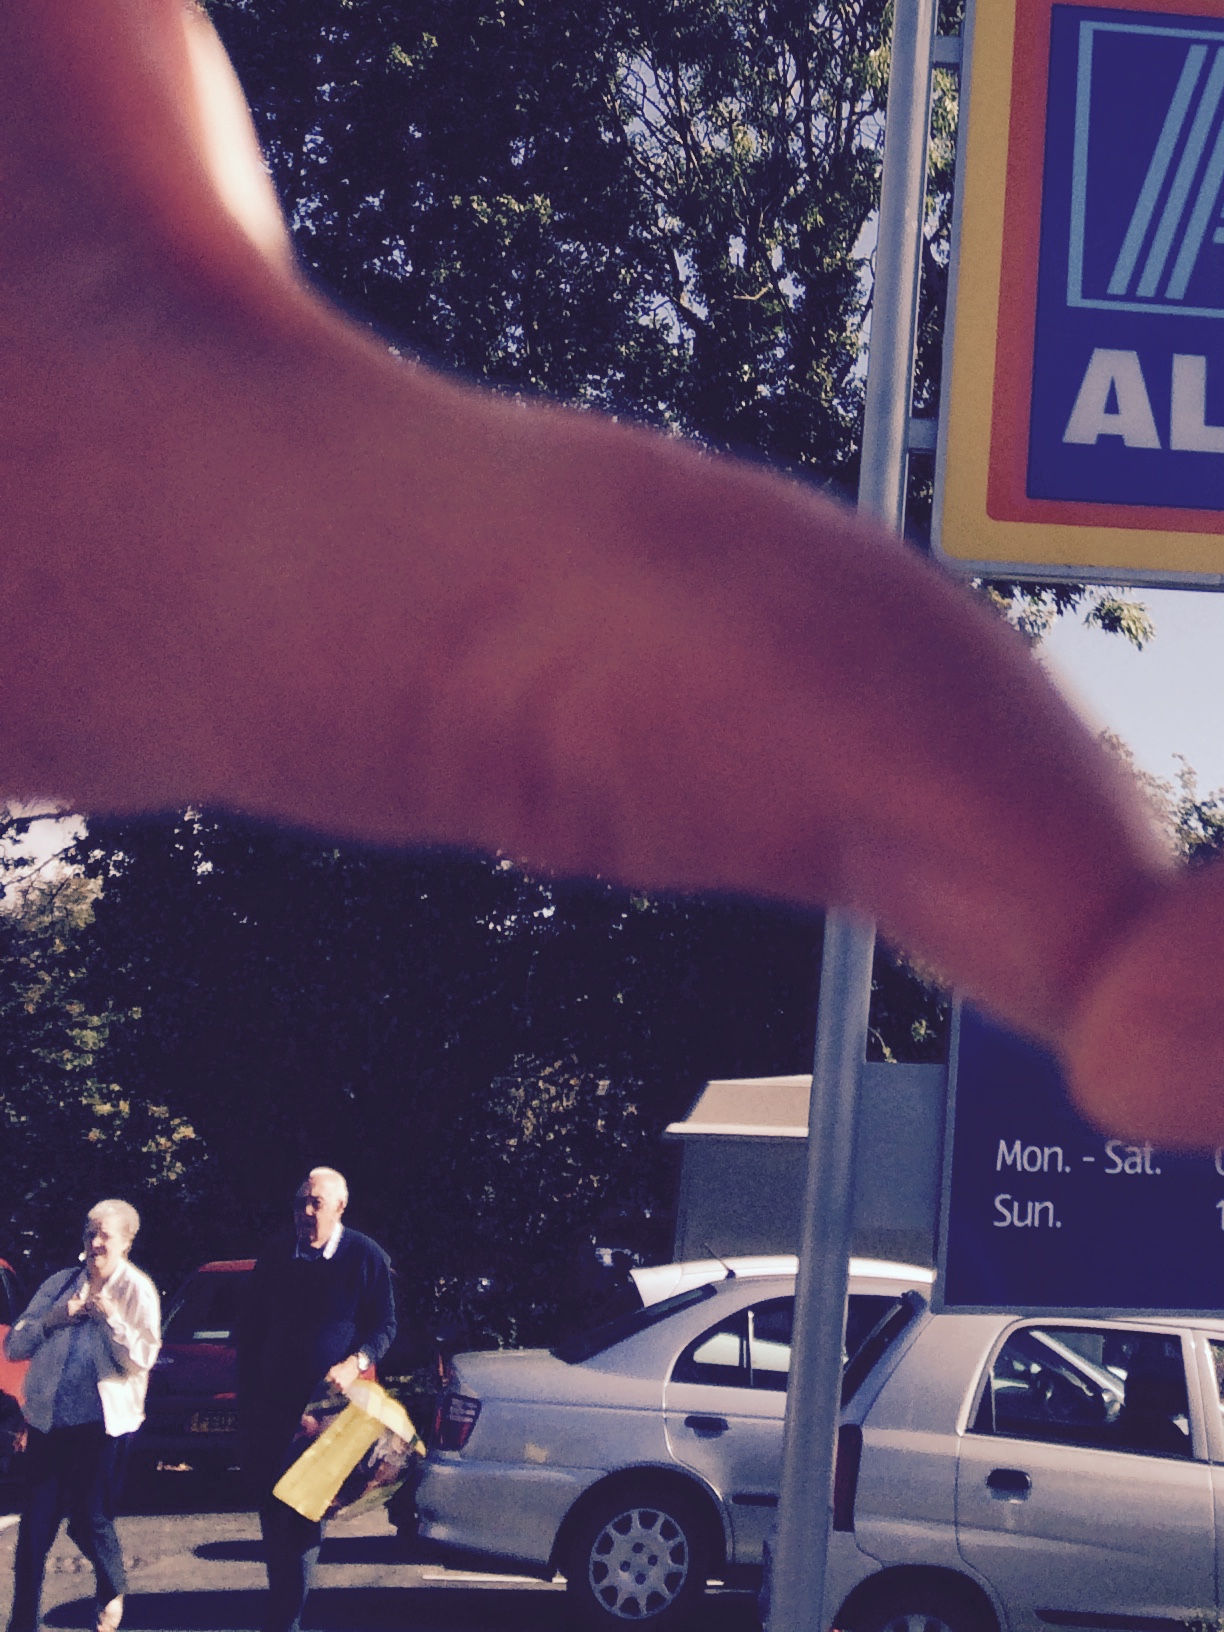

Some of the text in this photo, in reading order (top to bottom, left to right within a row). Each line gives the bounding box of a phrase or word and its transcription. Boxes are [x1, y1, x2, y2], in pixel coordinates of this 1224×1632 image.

[996, 1139, 1072, 1174] Mon.
[1104, 1139, 1162, 1175] Sat.
[993, 1193, 1062, 1229] Sun.
